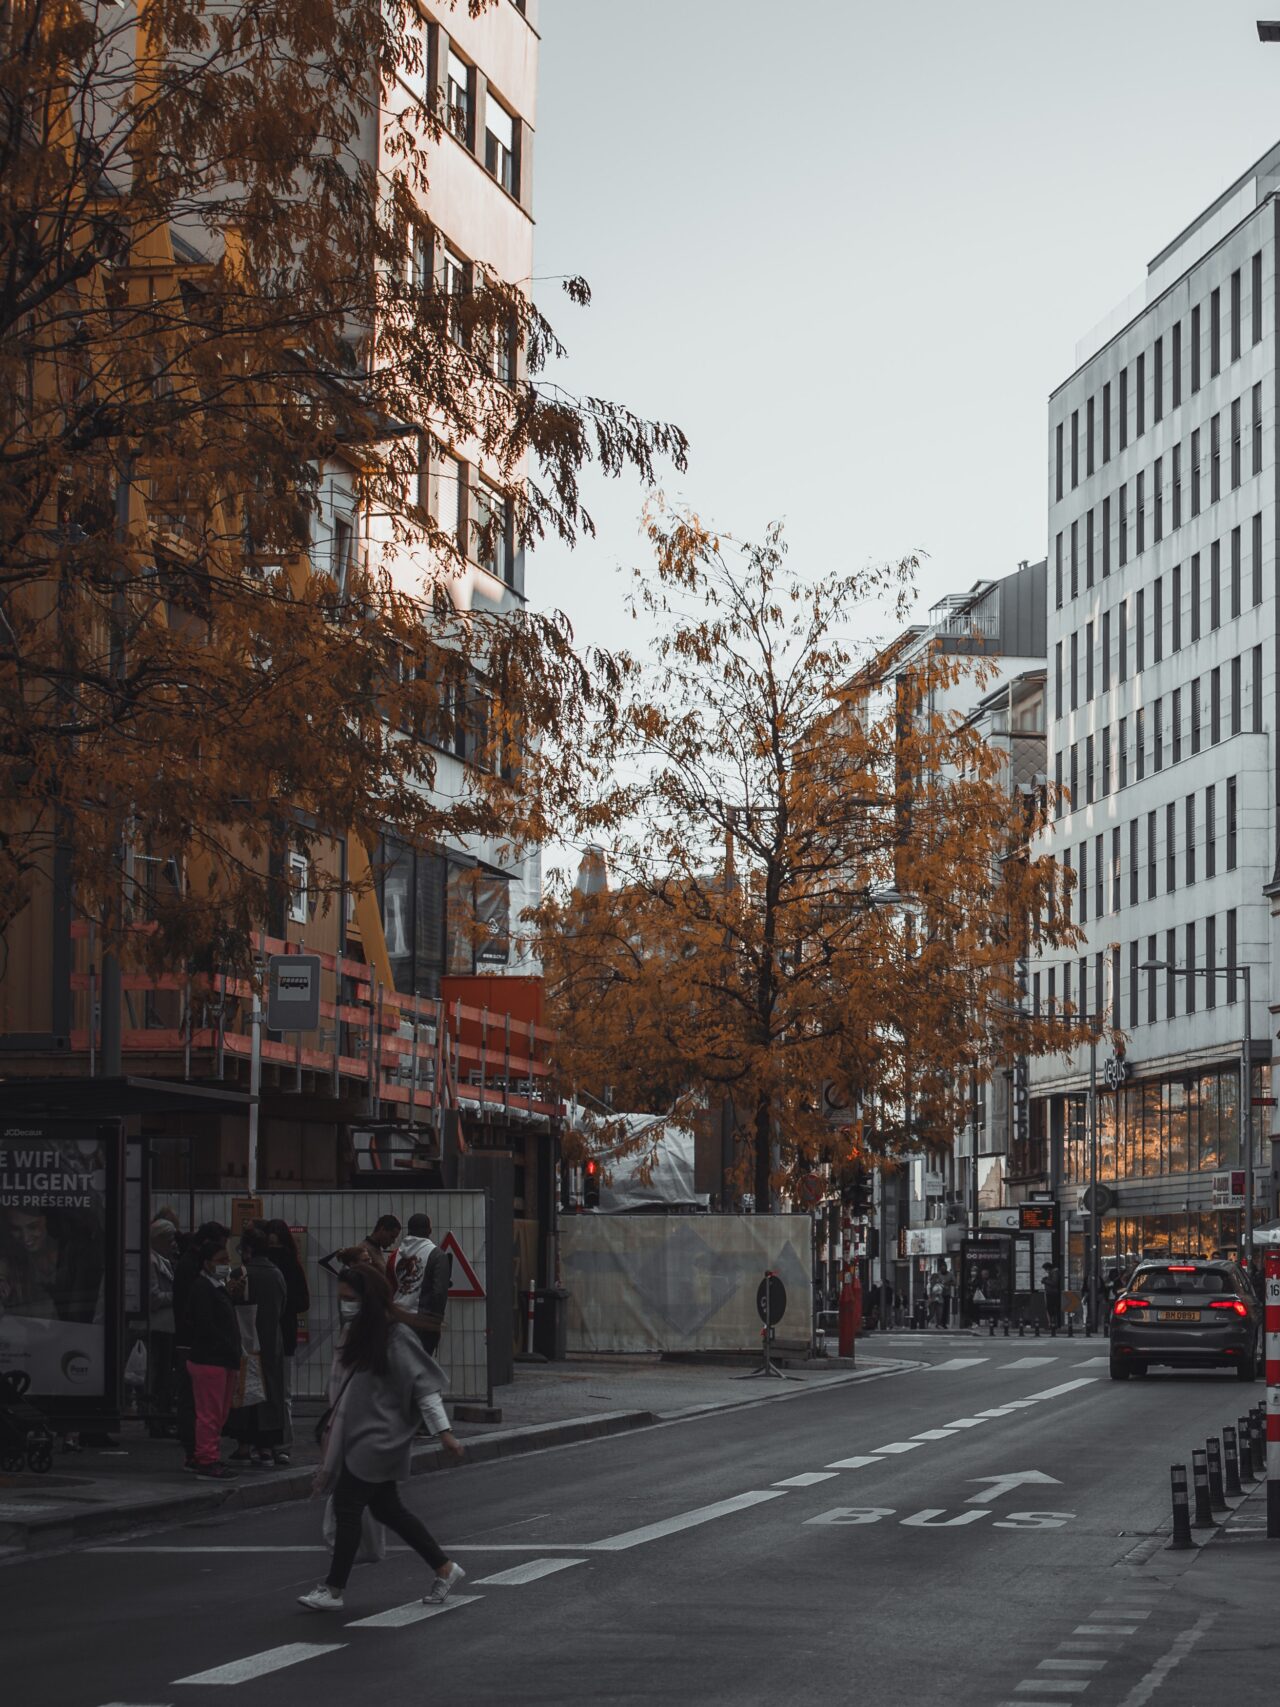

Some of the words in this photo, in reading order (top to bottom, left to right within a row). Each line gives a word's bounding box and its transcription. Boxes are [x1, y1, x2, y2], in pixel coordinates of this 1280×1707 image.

[1104, 1058, 1126, 1090] Regus
[13, 1151, 60, 1168] WIFI
[0, 1195, 20, 1207] US
[22, 1193, 92, 1208] PRÉSERVE
[1270, 1284, 1280, 1297] 16
[800, 1506, 1078, 1529] BUS
